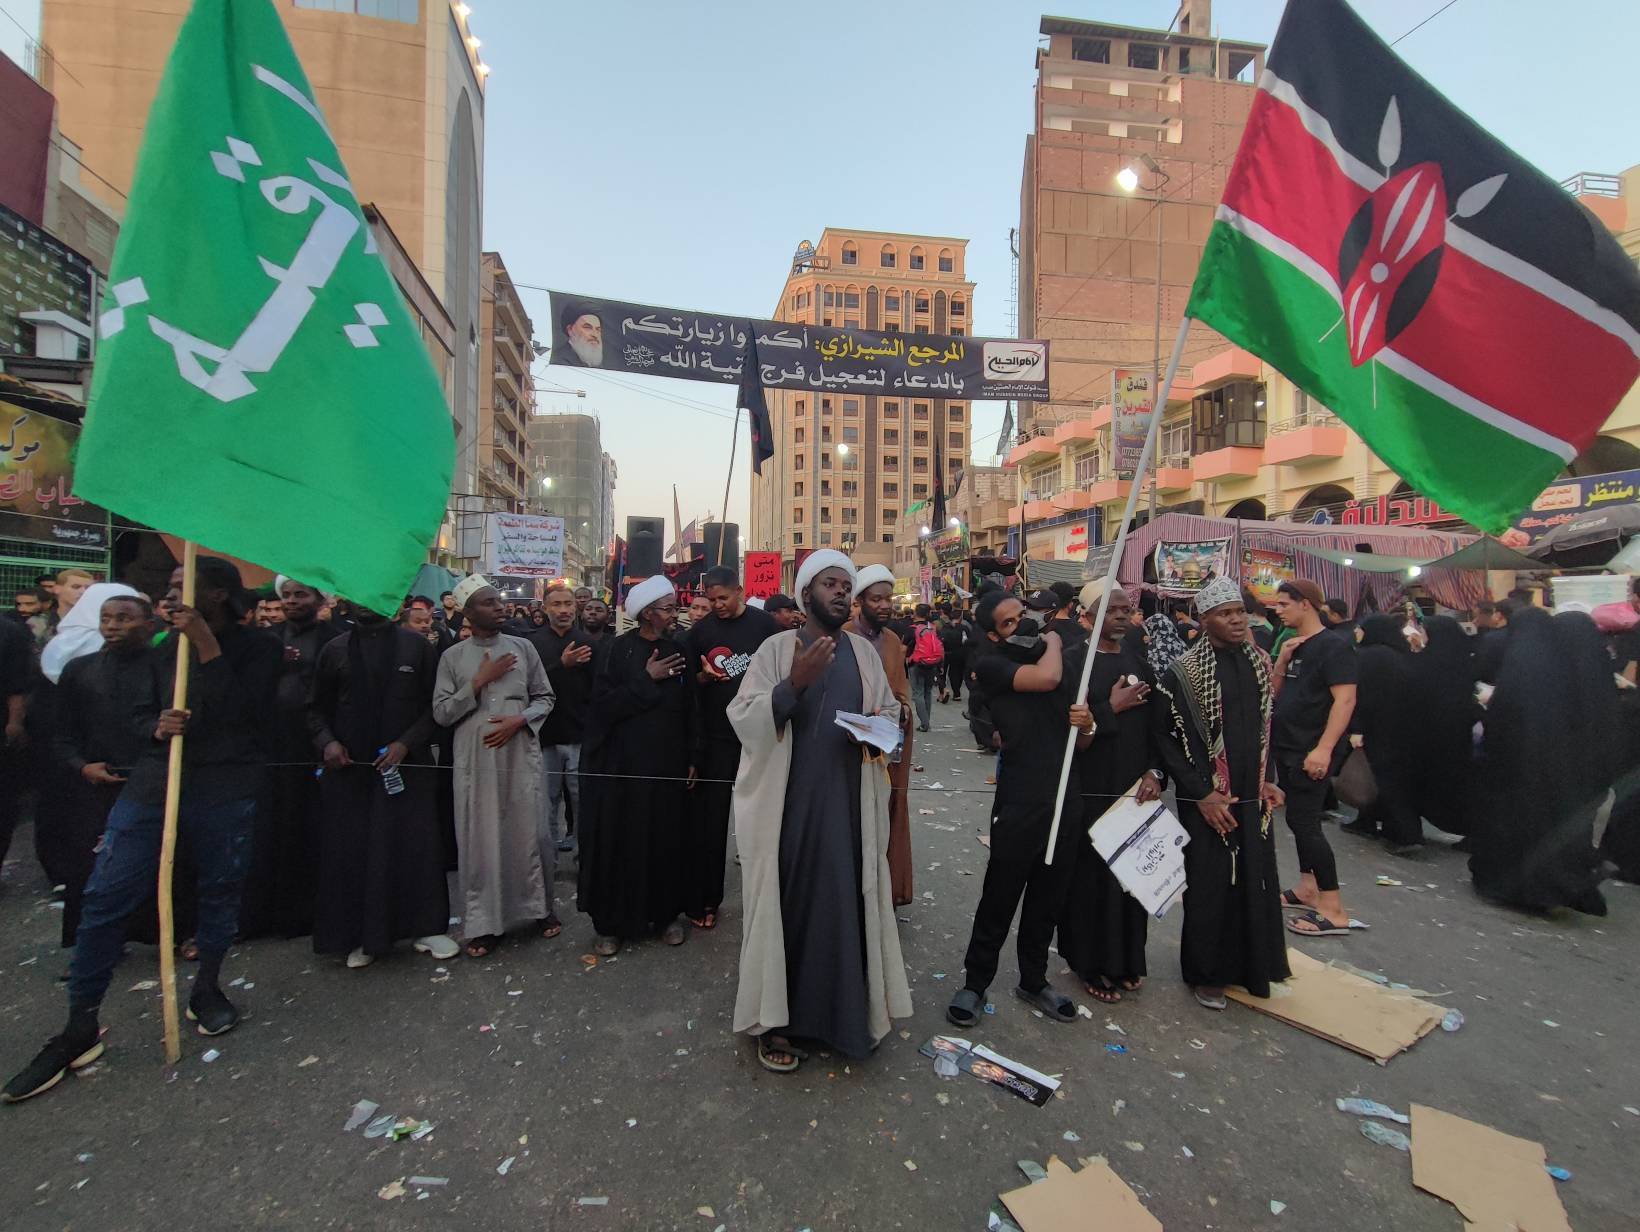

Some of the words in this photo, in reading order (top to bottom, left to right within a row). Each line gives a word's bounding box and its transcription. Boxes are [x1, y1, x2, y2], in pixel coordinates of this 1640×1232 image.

[621, 313, 725, 347] زيارتكم
[814, 334, 904, 362] الشيرازي:
[907, 342, 965, 367] المرجع
[760, 360, 806, 385] فرج
[809, 362, 885, 390] لتعجيل
[893, 371, 965, 394] بالدعاء
[36, 476, 85, 516] باب
[1584, 480, 1634, 508] منتظر
[753, 556, 774, 568] متى
[753, 570, 775, 583] نزور
